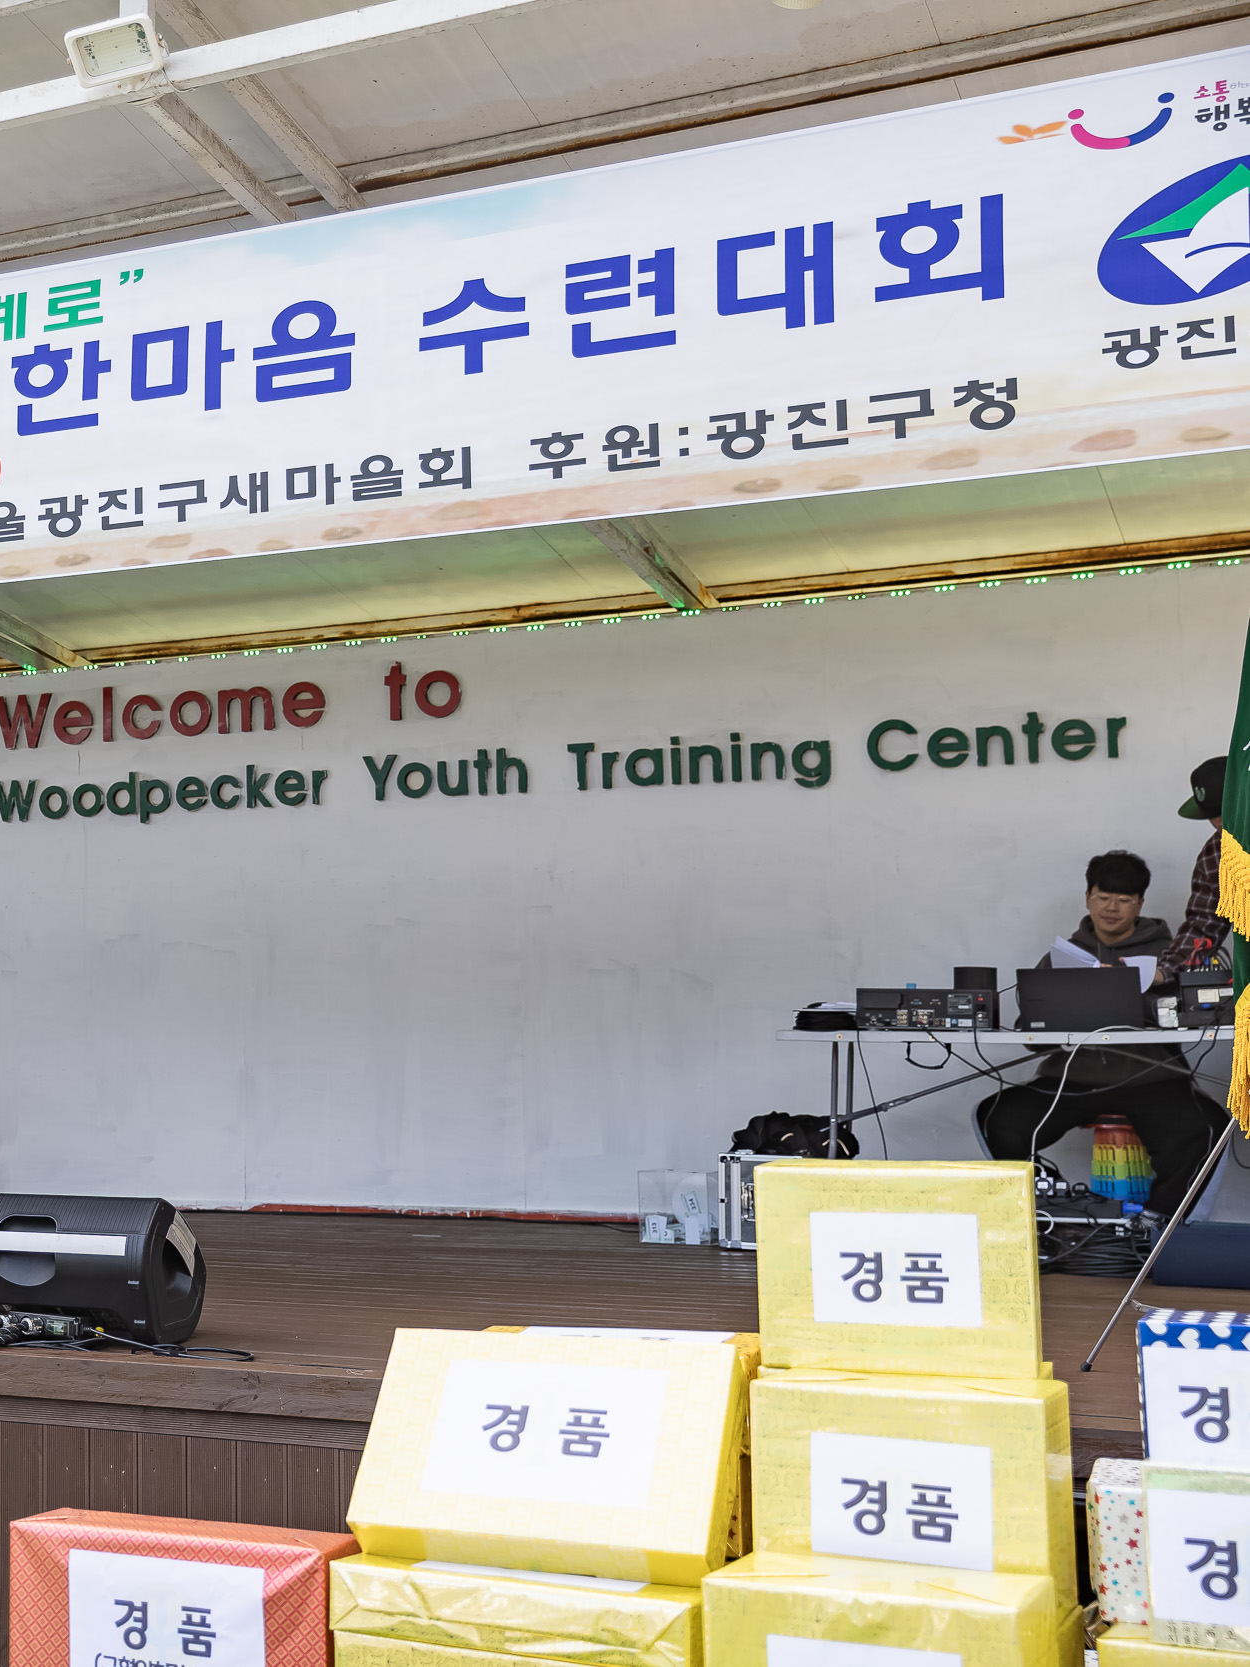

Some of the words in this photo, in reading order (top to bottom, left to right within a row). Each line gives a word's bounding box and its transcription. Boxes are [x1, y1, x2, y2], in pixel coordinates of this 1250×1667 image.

[1194, 80, 1230, 102] 소통
[11, 300, 356, 436] 한마음
[419, 193, 1005, 375] 수련대회
[528, 377, 1019, 480] 후원:광진구청
[383, 661, 461, 721] to
[362, 748, 528, 801] Youth
[567, 732, 831, 789] Training
[867, 712, 1127, 771] Center
